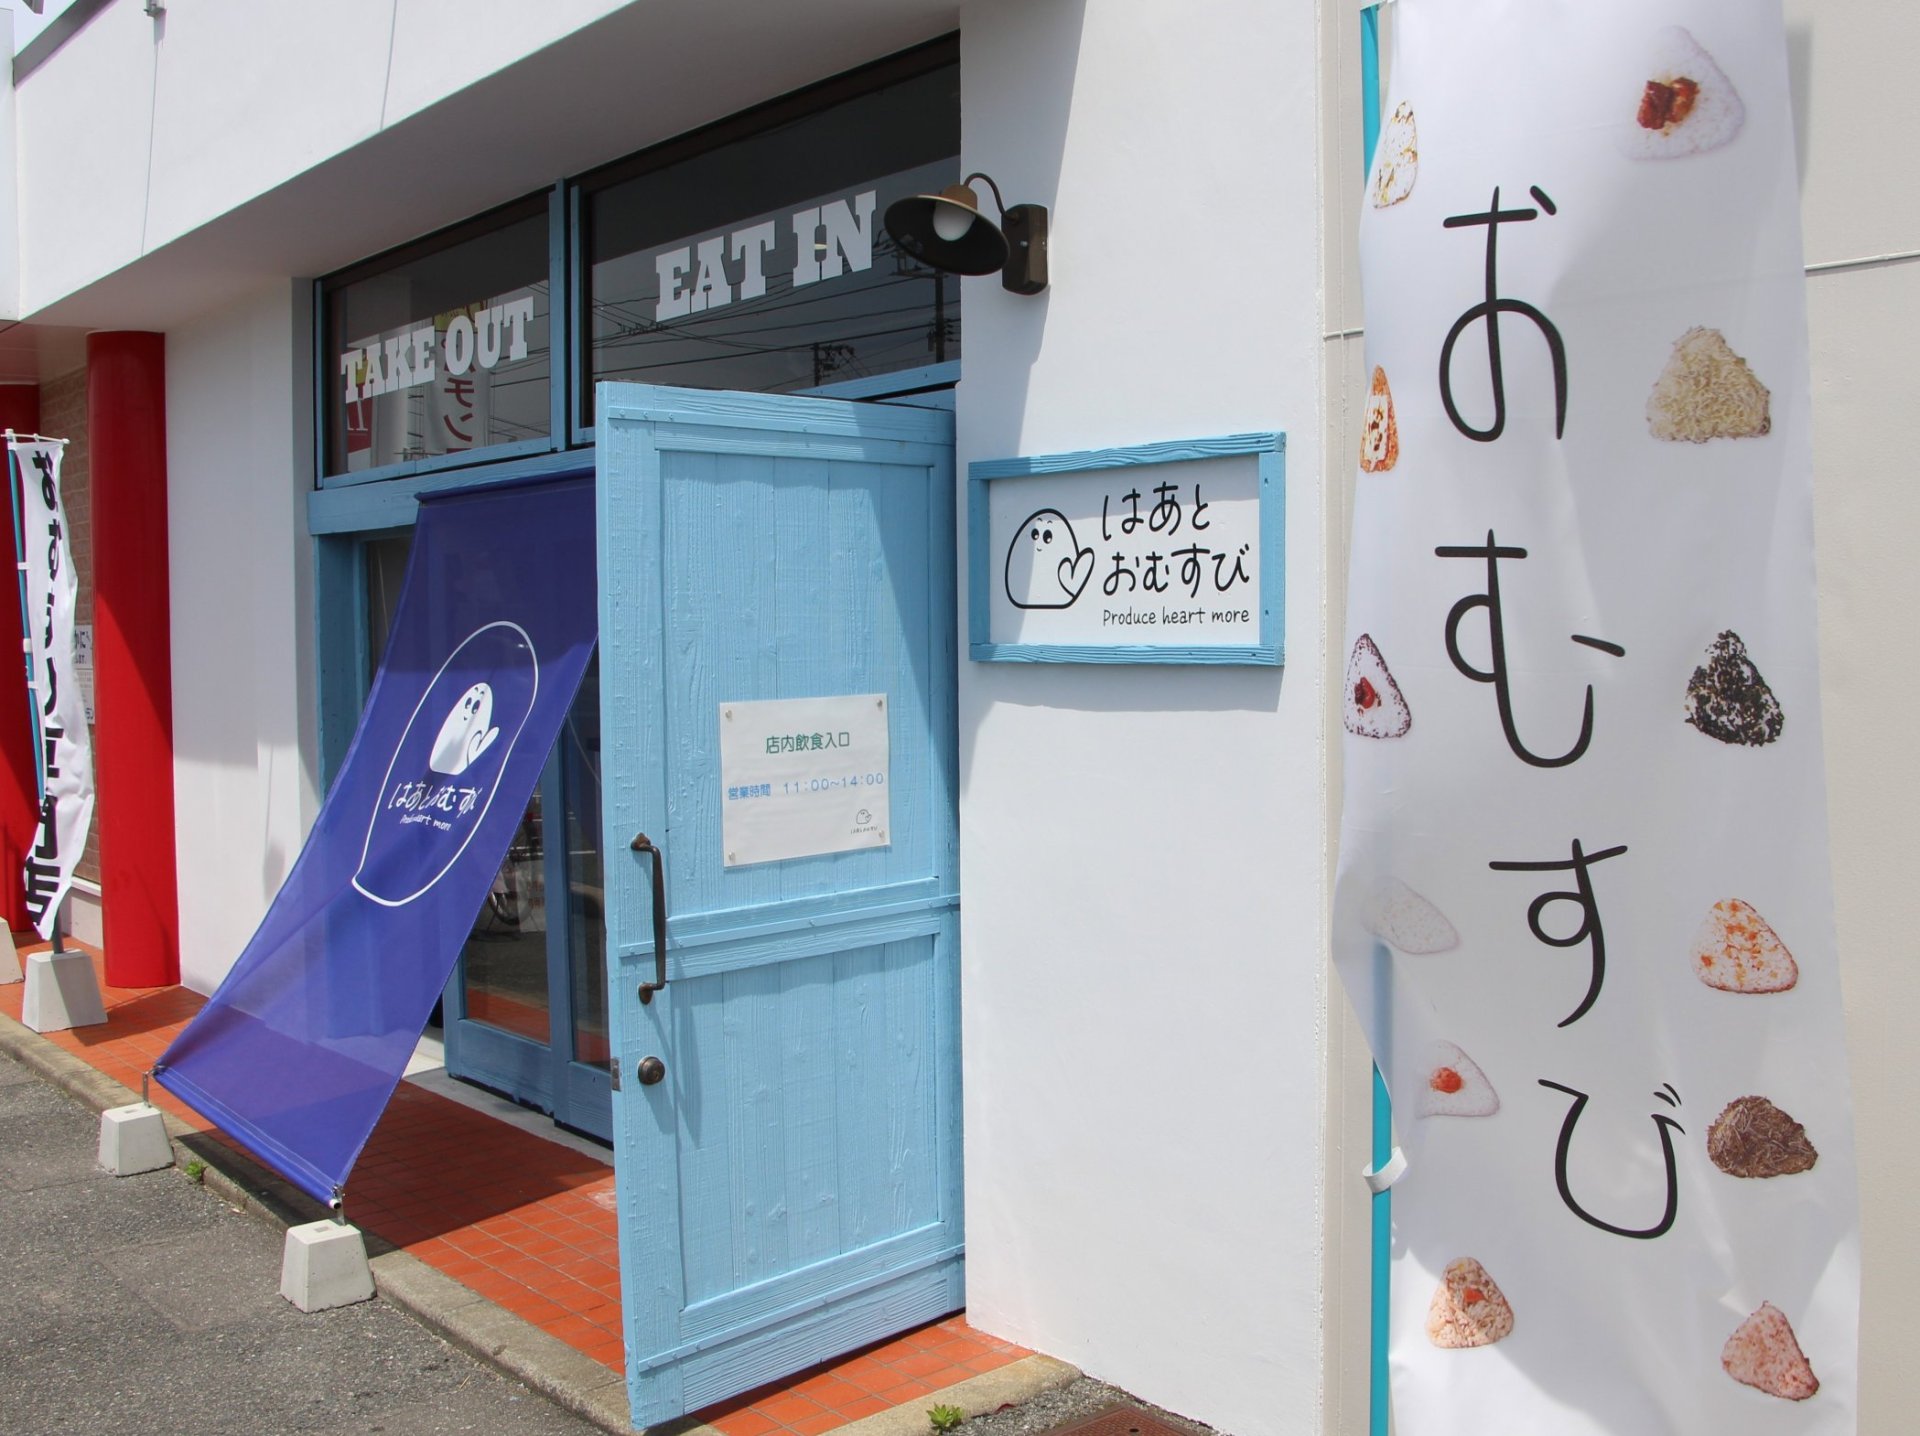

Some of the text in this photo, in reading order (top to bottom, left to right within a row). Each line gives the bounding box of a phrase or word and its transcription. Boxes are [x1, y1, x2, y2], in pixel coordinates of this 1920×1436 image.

[656, 190, 877, 322] EAT IN
[341, 296, 534, 404] TAKE OUT
[1102, 481, 1210, 541] はあと
[1103, 543, 1250, 598] おむすび
[1103, 606, 1250, 627] Produce heart more
[1434, 184, 1685, 1240] おむすび
[766, 731, 850, 754] 店内飲食入口
[728, 783, 771, 800] 営業時間
